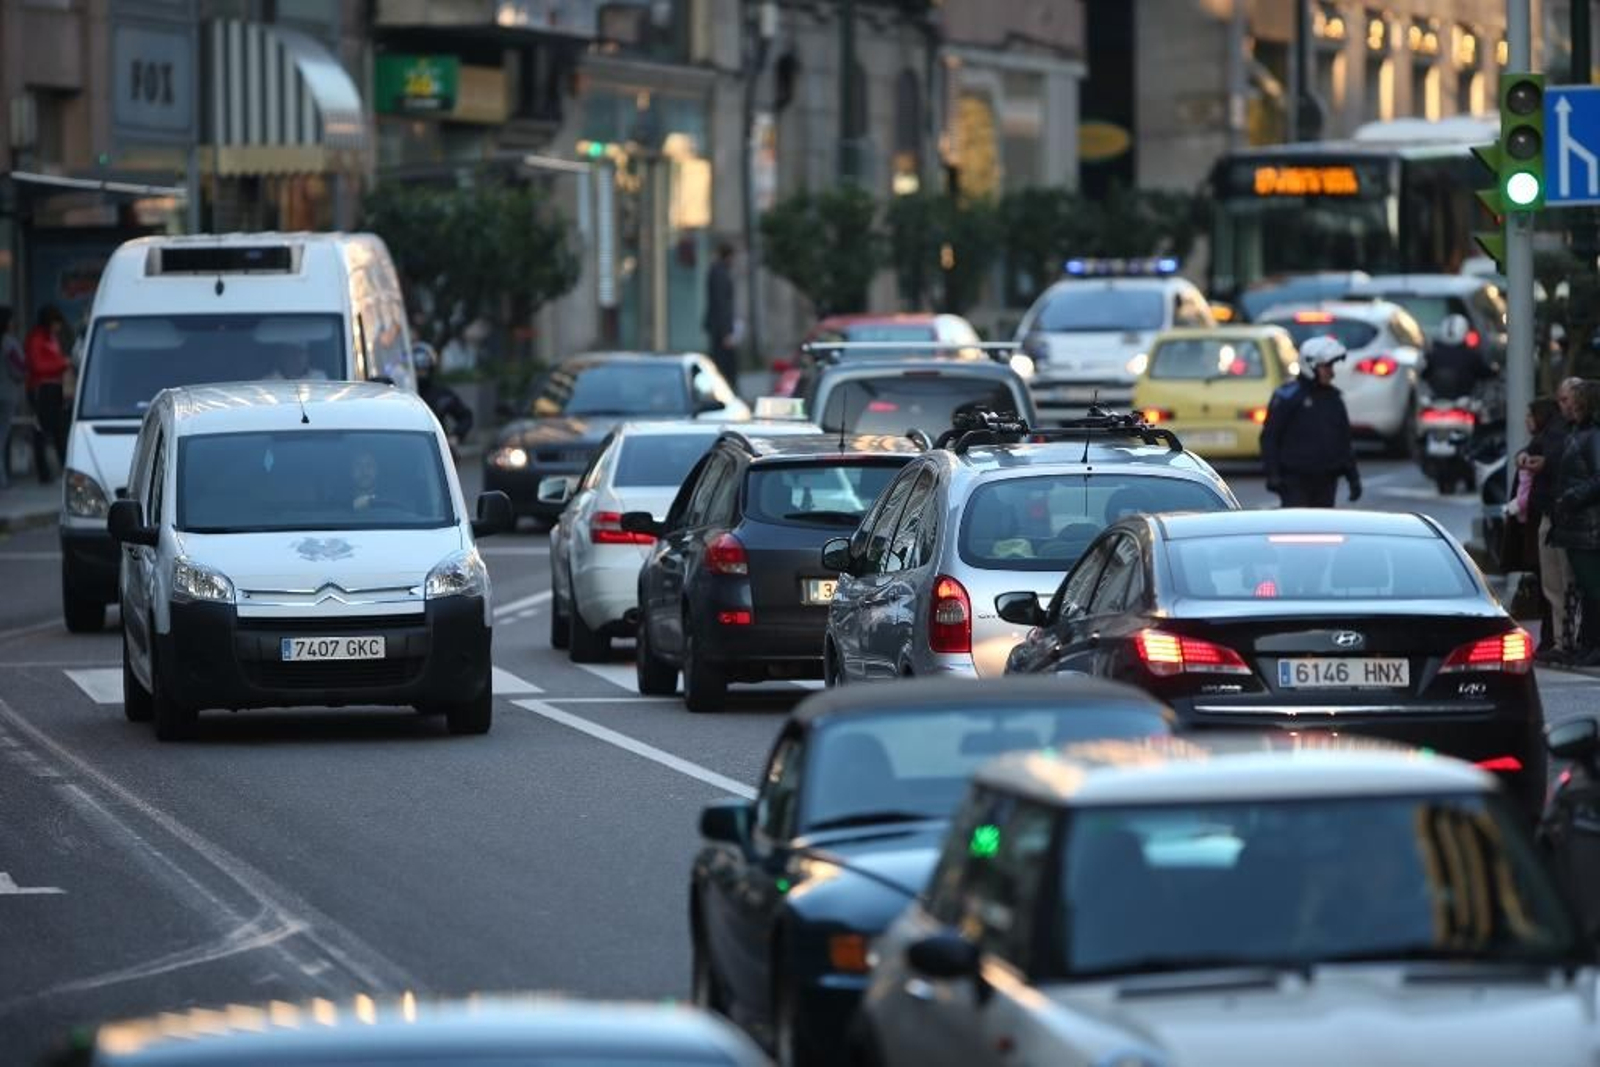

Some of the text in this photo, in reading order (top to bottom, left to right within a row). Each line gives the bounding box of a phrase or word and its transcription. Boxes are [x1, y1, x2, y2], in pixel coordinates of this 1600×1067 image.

[131, 59, 175, 105] FOX
[295, 639, 379, 657] 7407 GKC
[1296, 662, 1403, 683] 6146 HNX
